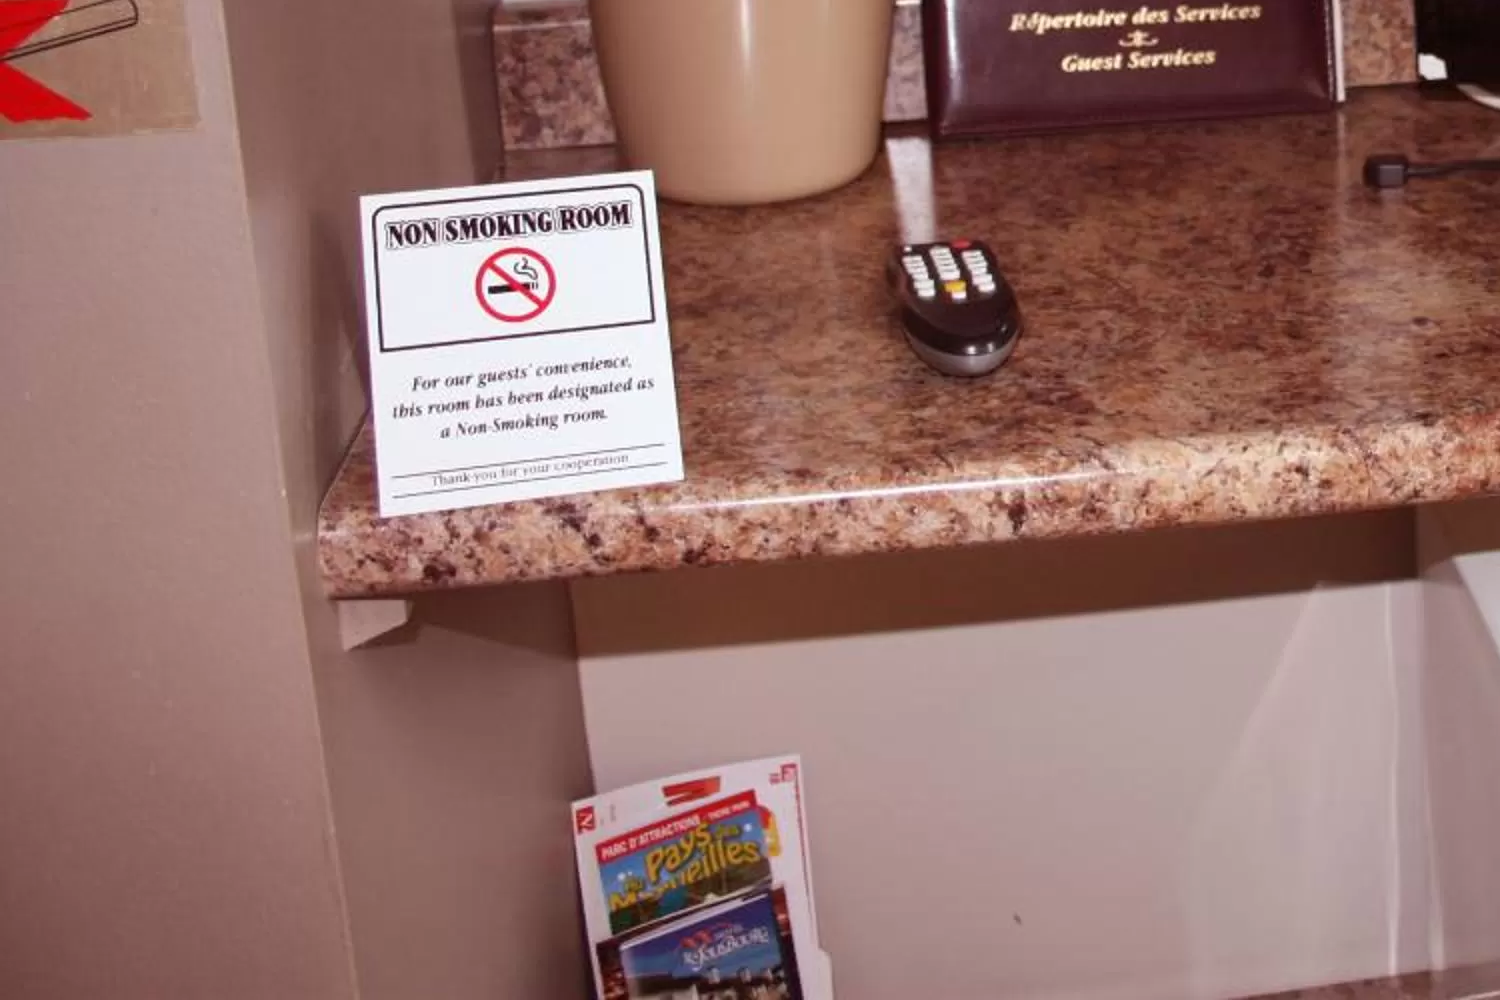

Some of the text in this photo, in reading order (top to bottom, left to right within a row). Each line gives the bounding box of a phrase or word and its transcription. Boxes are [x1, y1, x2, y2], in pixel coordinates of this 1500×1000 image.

[1009, 3, 1262, 35] Répertoire des Services
[1060, 48, 1217, 73] Guest Services
[386, 200, 633, 249] NON SMOKING ROOM
[392, 376, 655, 420] this room has been designated as
[411, 375, 438, 392] For
[444, 374, 472, 388] our
[439, 427, 451, 440] a
[456, 411, 560, 438] Non-Smoking
[521, 461, 549, 476] your
[553, 453, 629, 471] cooperation
[644, 821, 712, 885] Pays
[607, 839, 763, 912] Meilles
